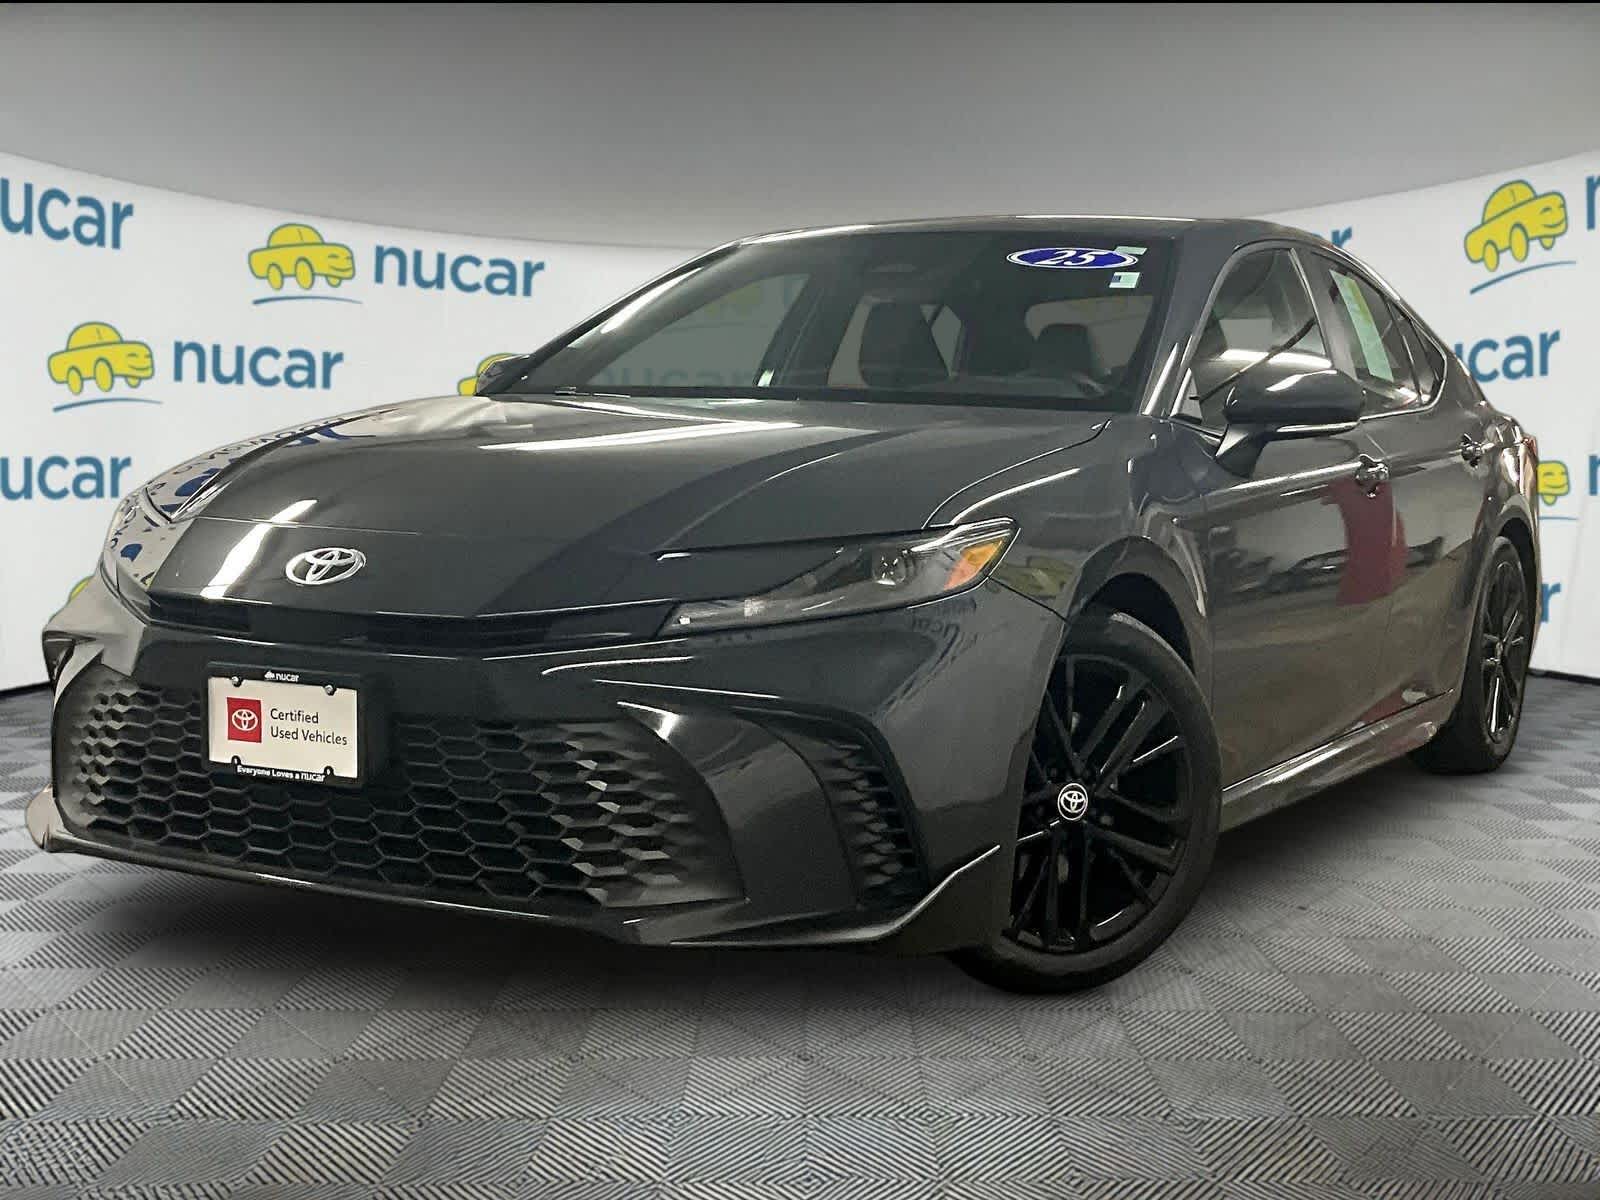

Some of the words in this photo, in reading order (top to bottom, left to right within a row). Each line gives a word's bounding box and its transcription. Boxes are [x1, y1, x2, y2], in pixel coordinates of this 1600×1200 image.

[0, 177, 134, 250] ucar
[374, 244, 545, 297] nucar
[1033, 250, 1108, 266] 25
[173, 340, 344, 390] nucar
[1454, 329, 1561, 384] car
[0, 455, 132, 501] ucar
[275, 672, 300, 683] nucar
[270, 708, 319, 725] Certified
[270, 726, 299, 741] Used
[301, 730, 348, 746] Vehicles
[236, 765, 271, 777] Everyone
[271, 769, 294, 779] Loves
[300, 772, 326, 783] nucar
